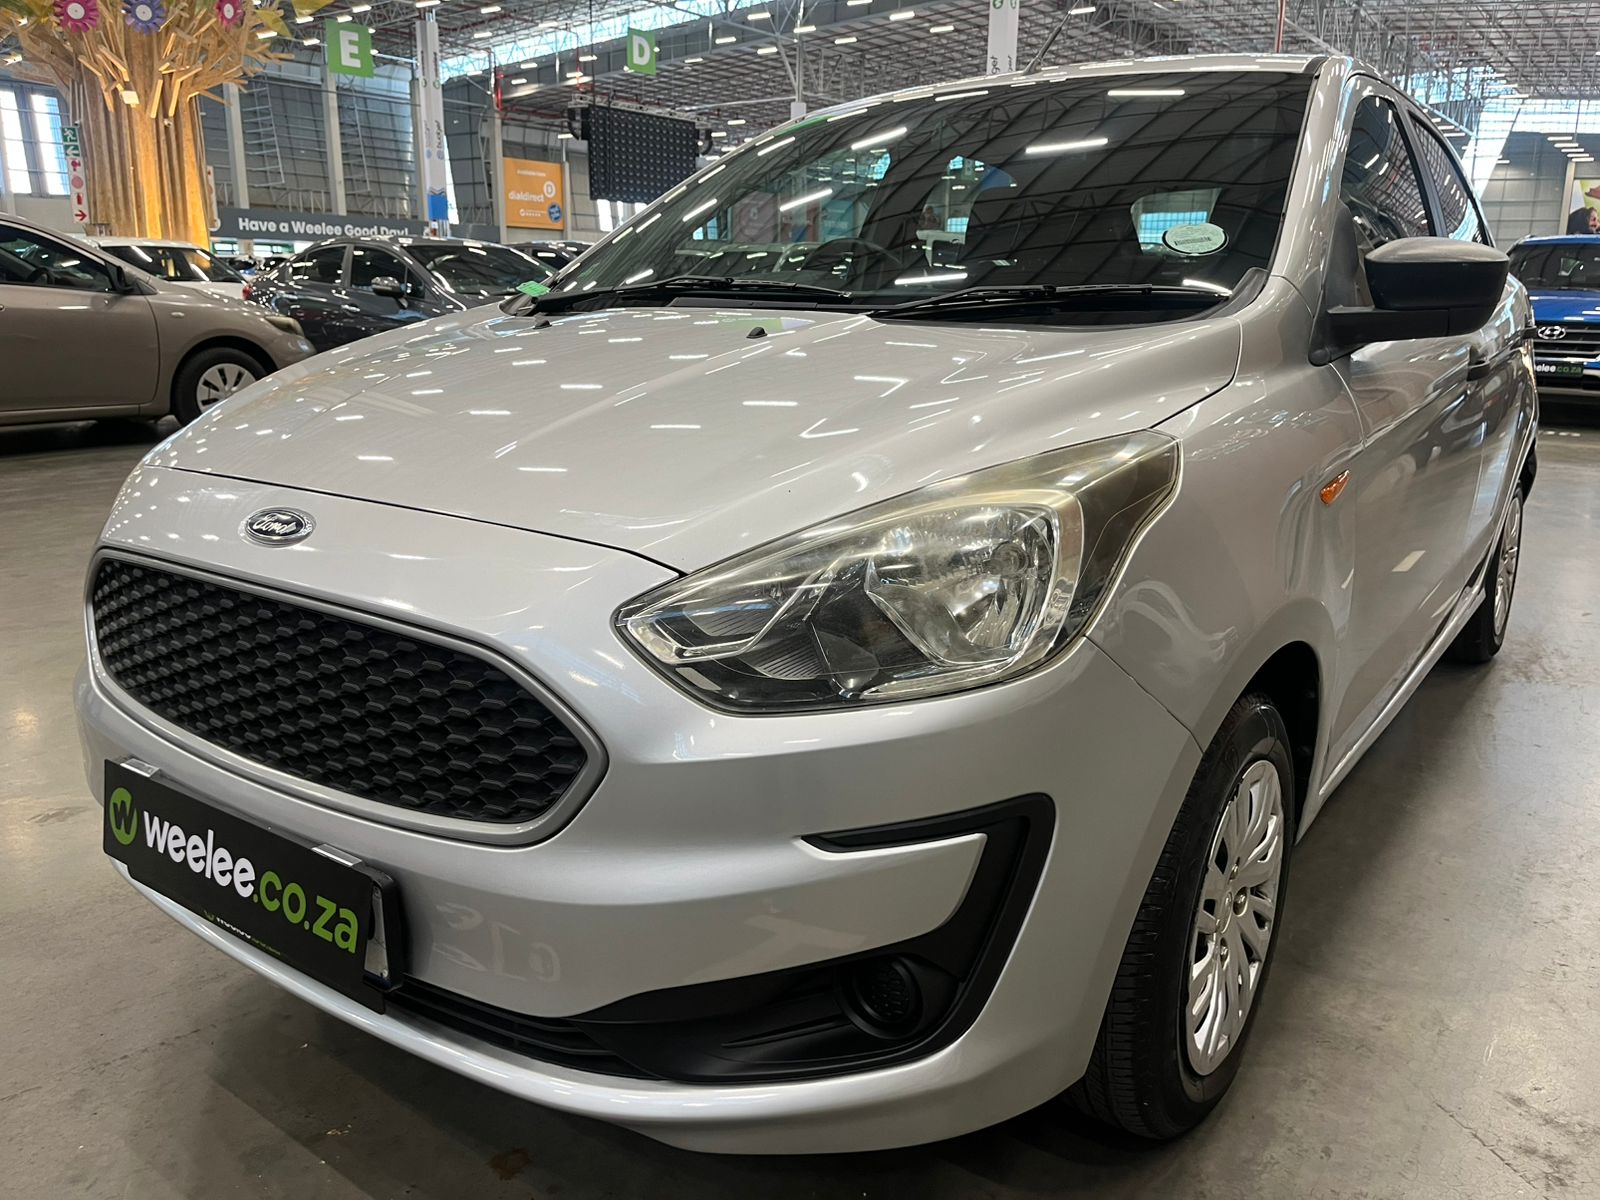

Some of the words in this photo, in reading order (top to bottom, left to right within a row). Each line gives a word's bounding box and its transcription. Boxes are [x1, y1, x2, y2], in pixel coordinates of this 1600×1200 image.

[339, 31, 361, 68] E
[633, 36, 650, 65] D
[238, 217, 277, 232] Have
[279, 222, 289, 233] a
[291, 220, 342, 236] Weelee
[344, 224, 377, 236] Good
[252, 512, 297, 534] Ford
[143, 811, 359, 954] weelee.co.za
